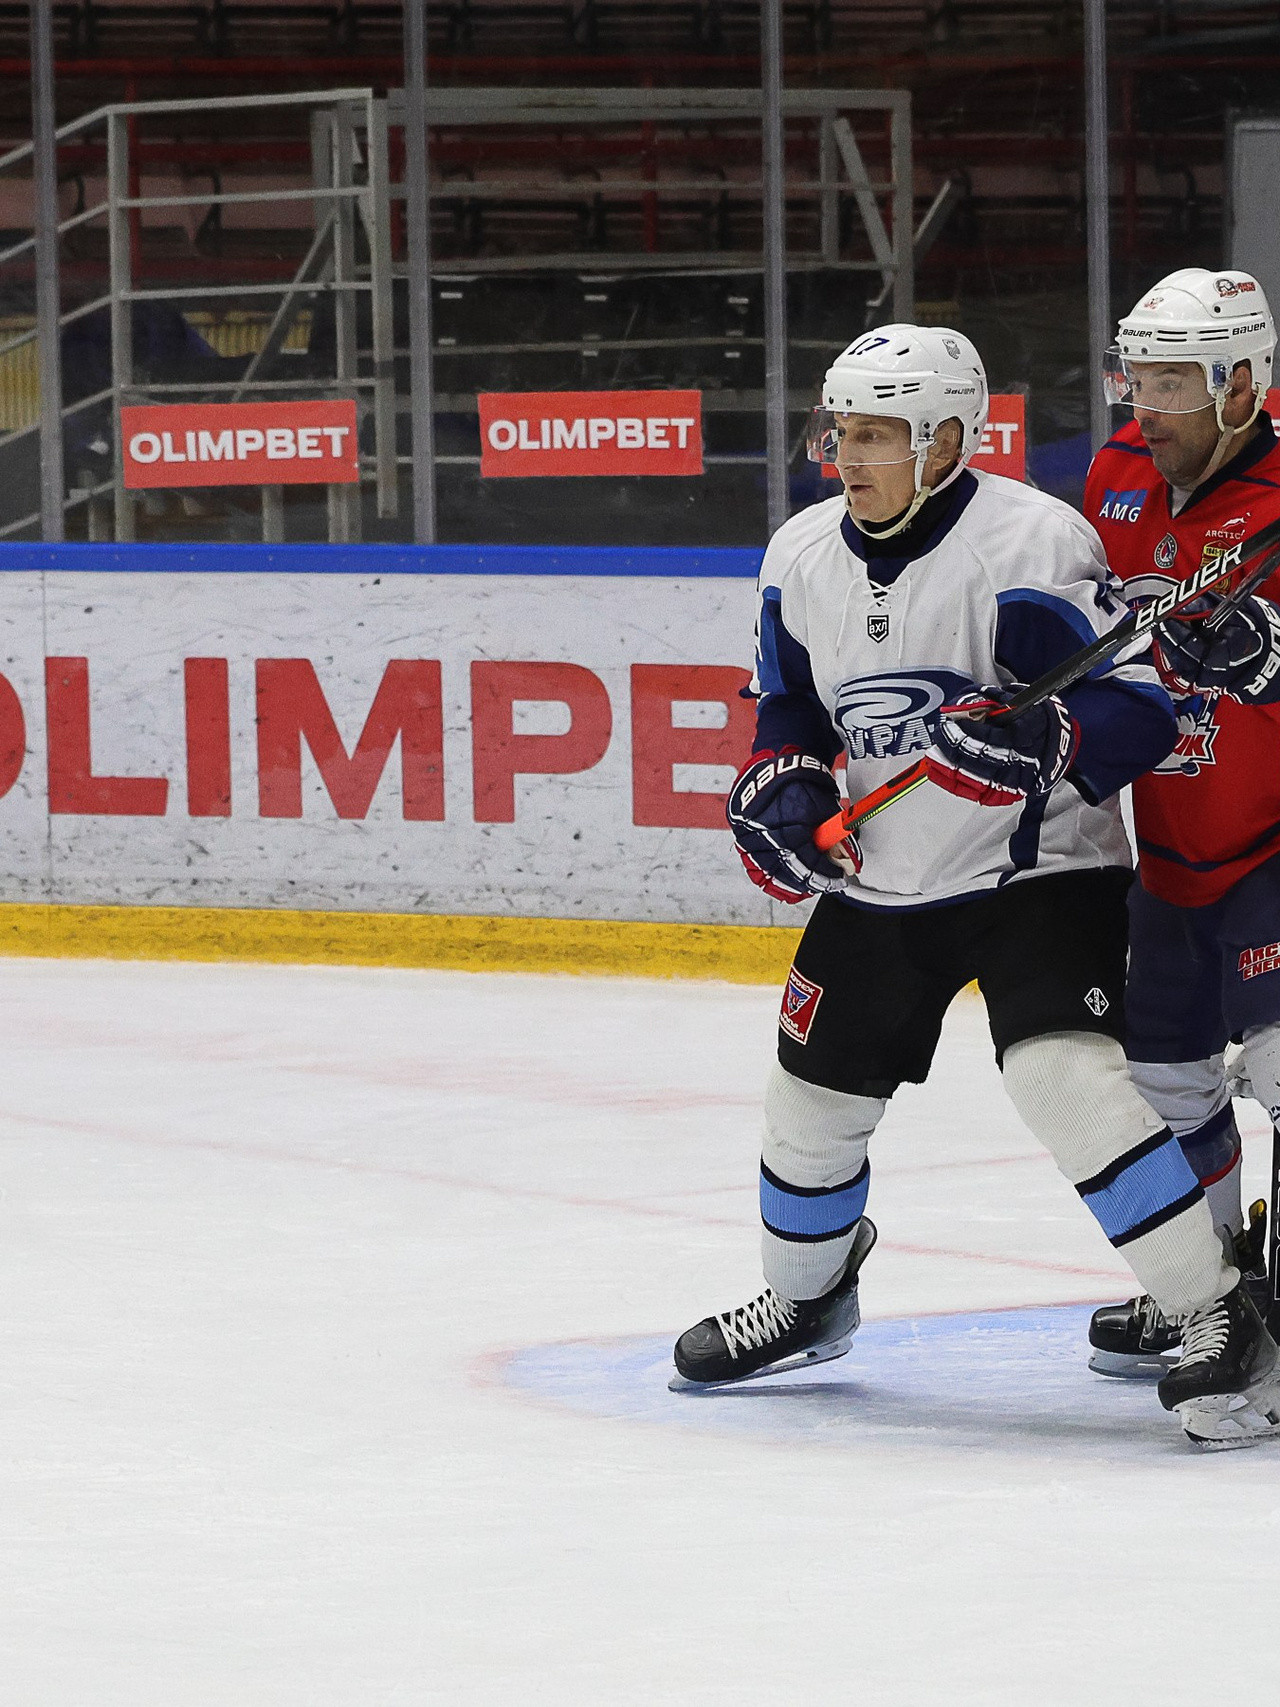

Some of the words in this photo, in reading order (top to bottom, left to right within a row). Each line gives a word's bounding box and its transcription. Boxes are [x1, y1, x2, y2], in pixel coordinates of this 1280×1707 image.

[1122, 328, 1153, 338] BAUER
[129, 426, 349, 464] OLIMPBET
[487, 417, 695, 451] OLIMPBET
[1099, 501, 1142, 523] AMG
[0, 656, 760, 831] LIMPB
